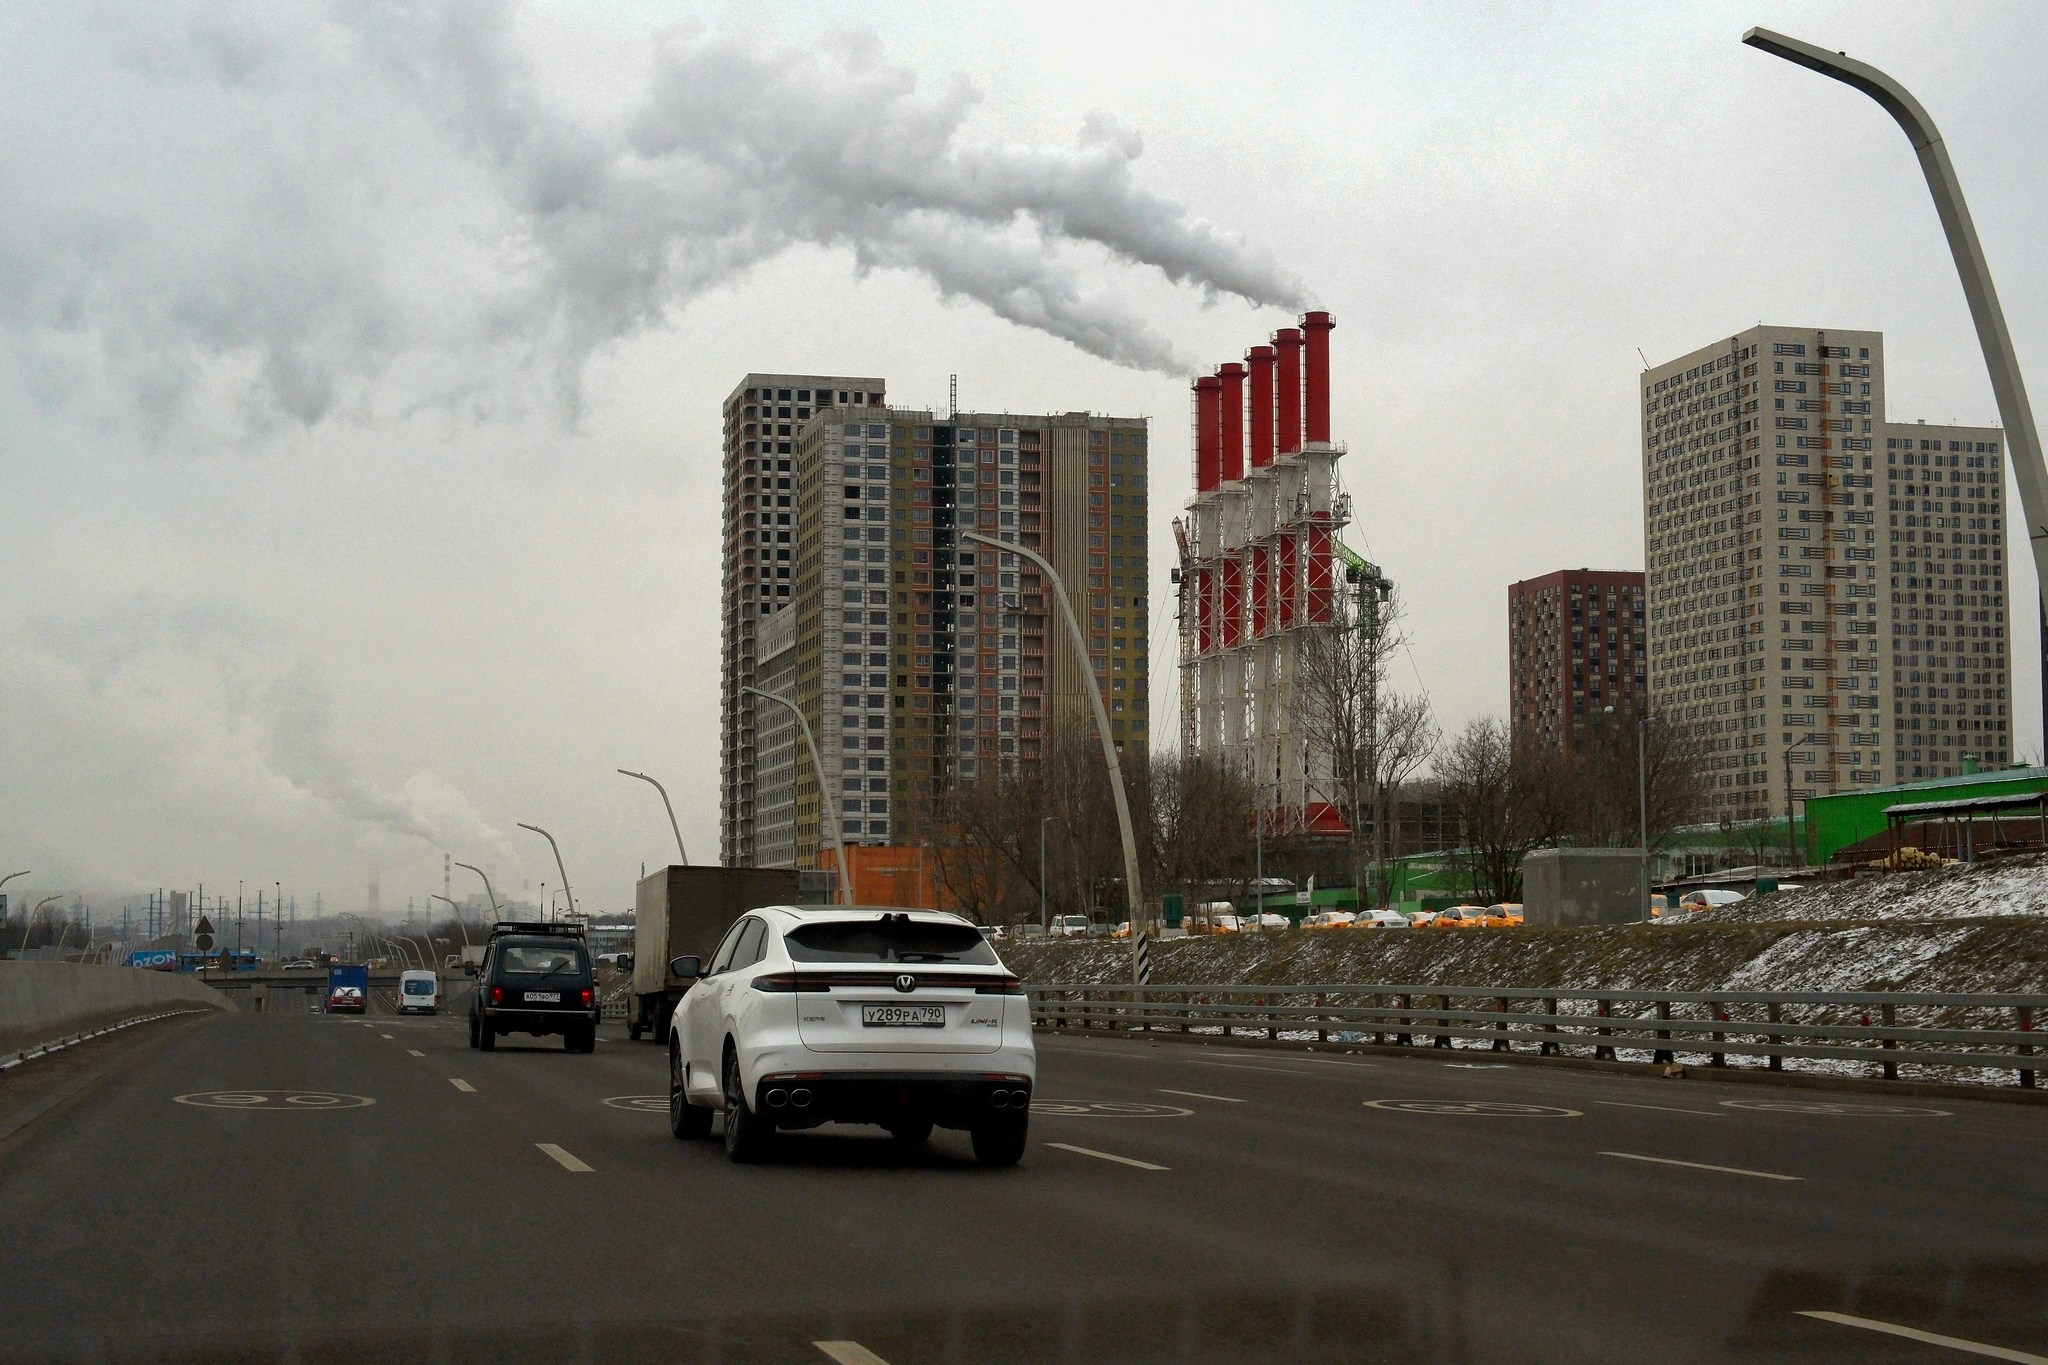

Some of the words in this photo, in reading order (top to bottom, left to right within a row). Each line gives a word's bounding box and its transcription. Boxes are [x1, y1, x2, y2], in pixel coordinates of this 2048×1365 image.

[133, 952, 176, 968] OZON
[868, 1008, 919, 1021] У289РА
[921, 1008, 941, 1018] 790
[212, 1094, 341, 1105] 90
